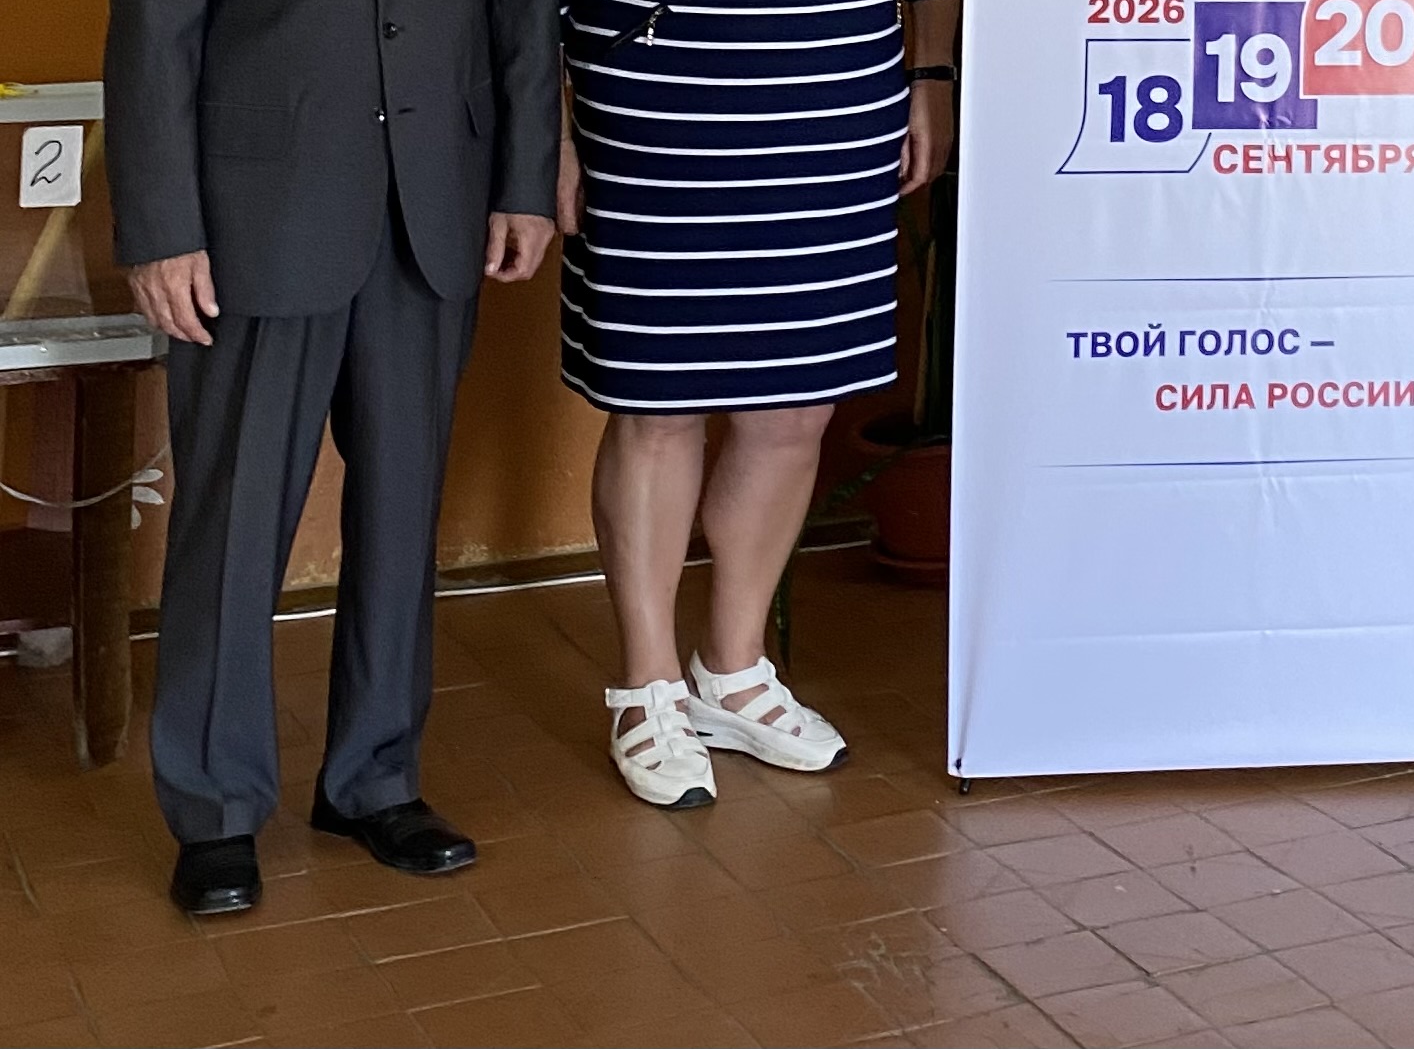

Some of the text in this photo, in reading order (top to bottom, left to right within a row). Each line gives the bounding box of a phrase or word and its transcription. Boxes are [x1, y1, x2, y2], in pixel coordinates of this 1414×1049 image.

[1098, 74, 1184, 143] 18
[1205, 32, 1293, 103] 19
[30, 140, 62, 187] 2
[1066, 323, 1167, 358] ТВОЙ
[1178, 328, 1300, 357] ГОЛОС
[1155, 382, 1256, 411] СИЛА
